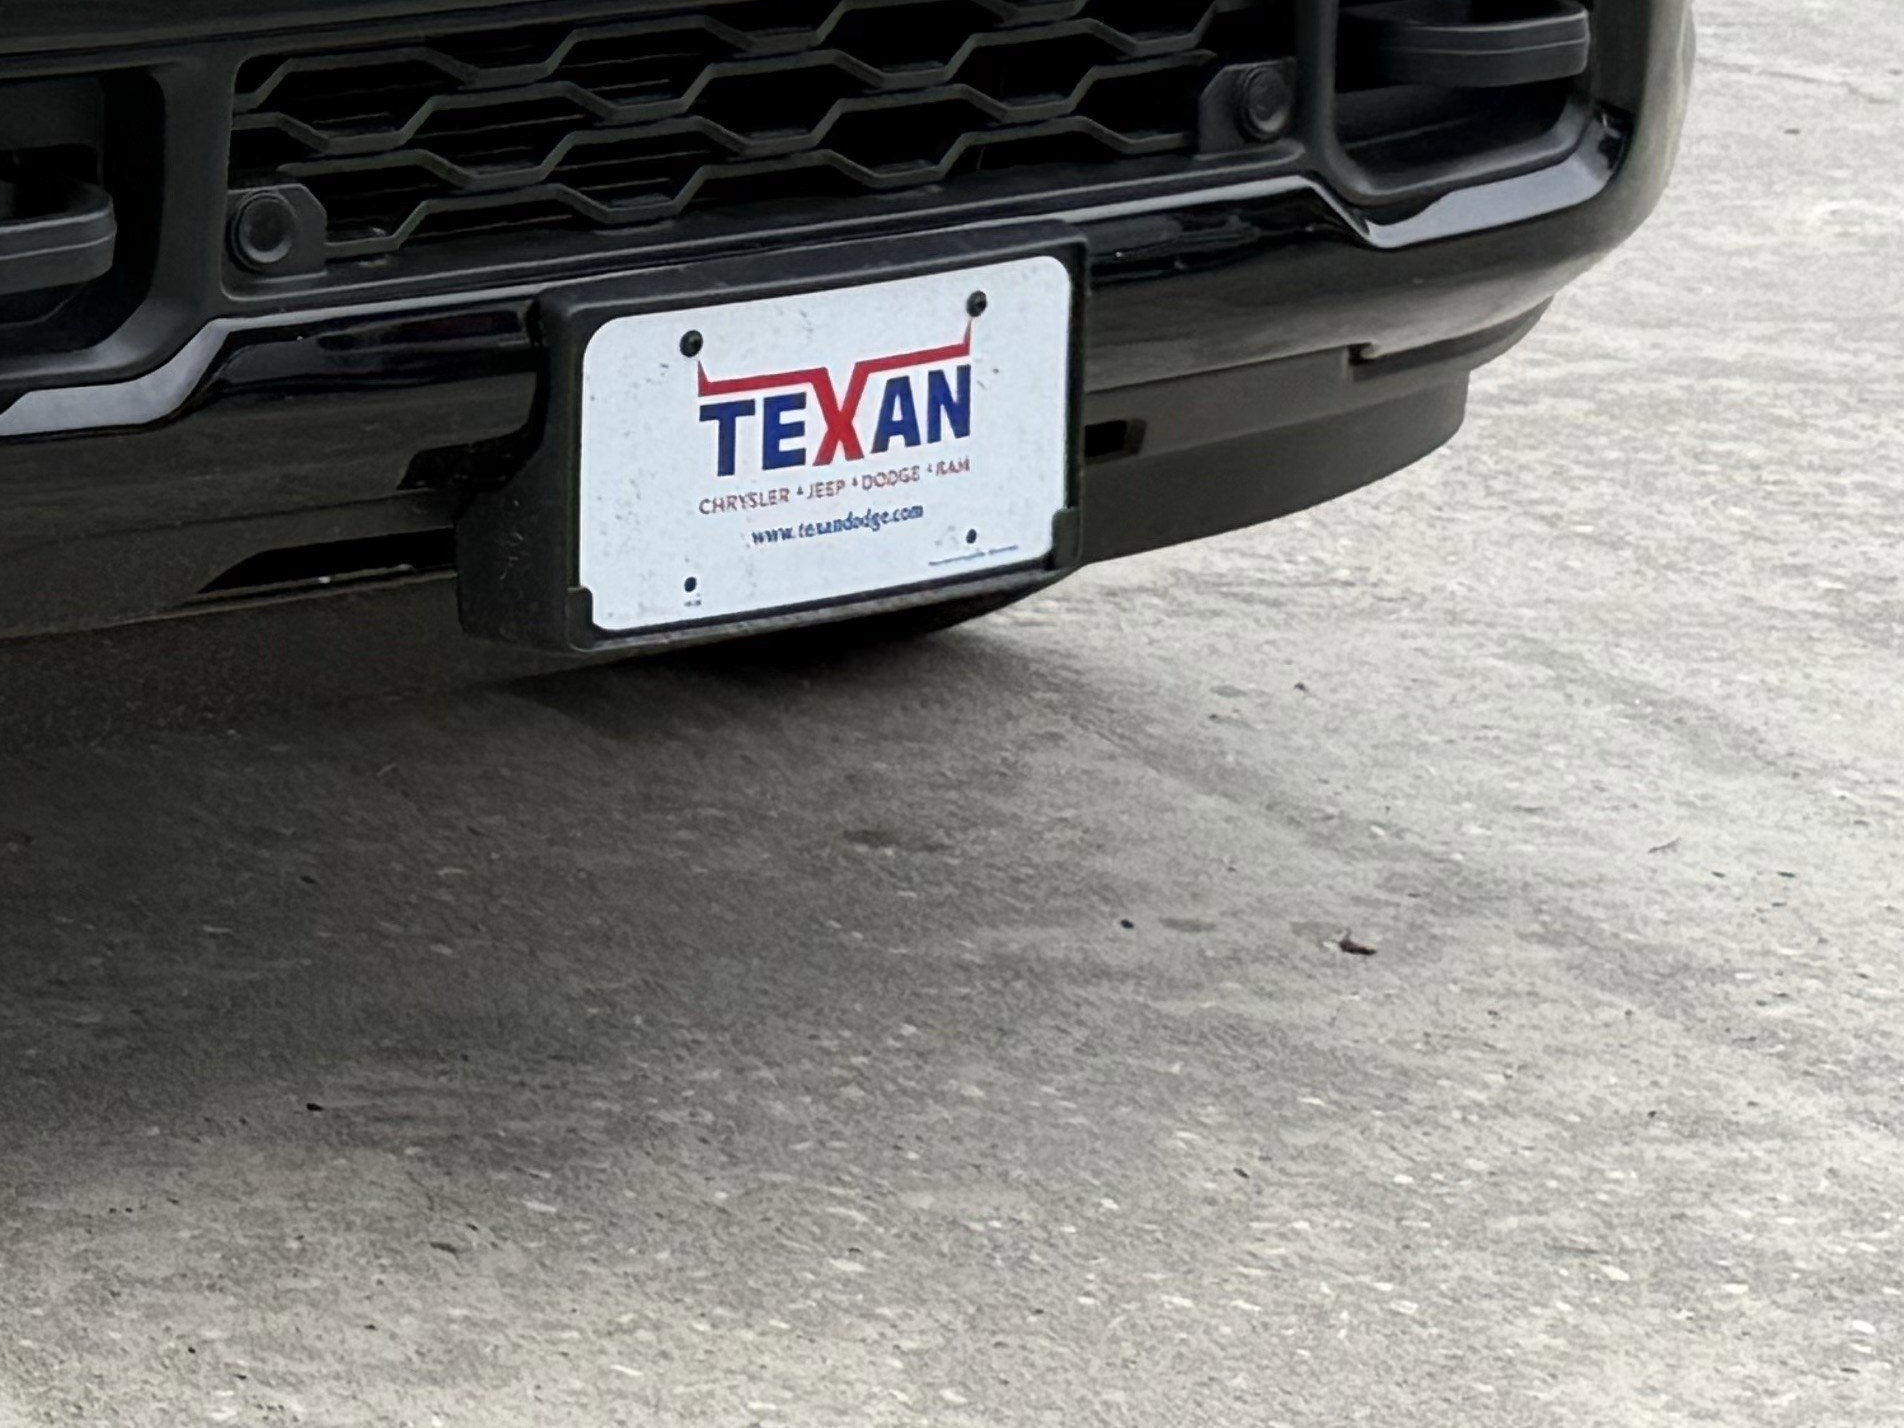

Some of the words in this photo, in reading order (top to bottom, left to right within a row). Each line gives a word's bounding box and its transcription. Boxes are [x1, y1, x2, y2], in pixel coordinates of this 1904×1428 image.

[697, 362, 972, 477] TEXAN
[698, 487, 791, 516] CHRYSLER
[806, 479, 846, 500] JEEP
[861, 465, 921, 491] DODGE
[751, 504, 925, 545] www.texandodge.com
